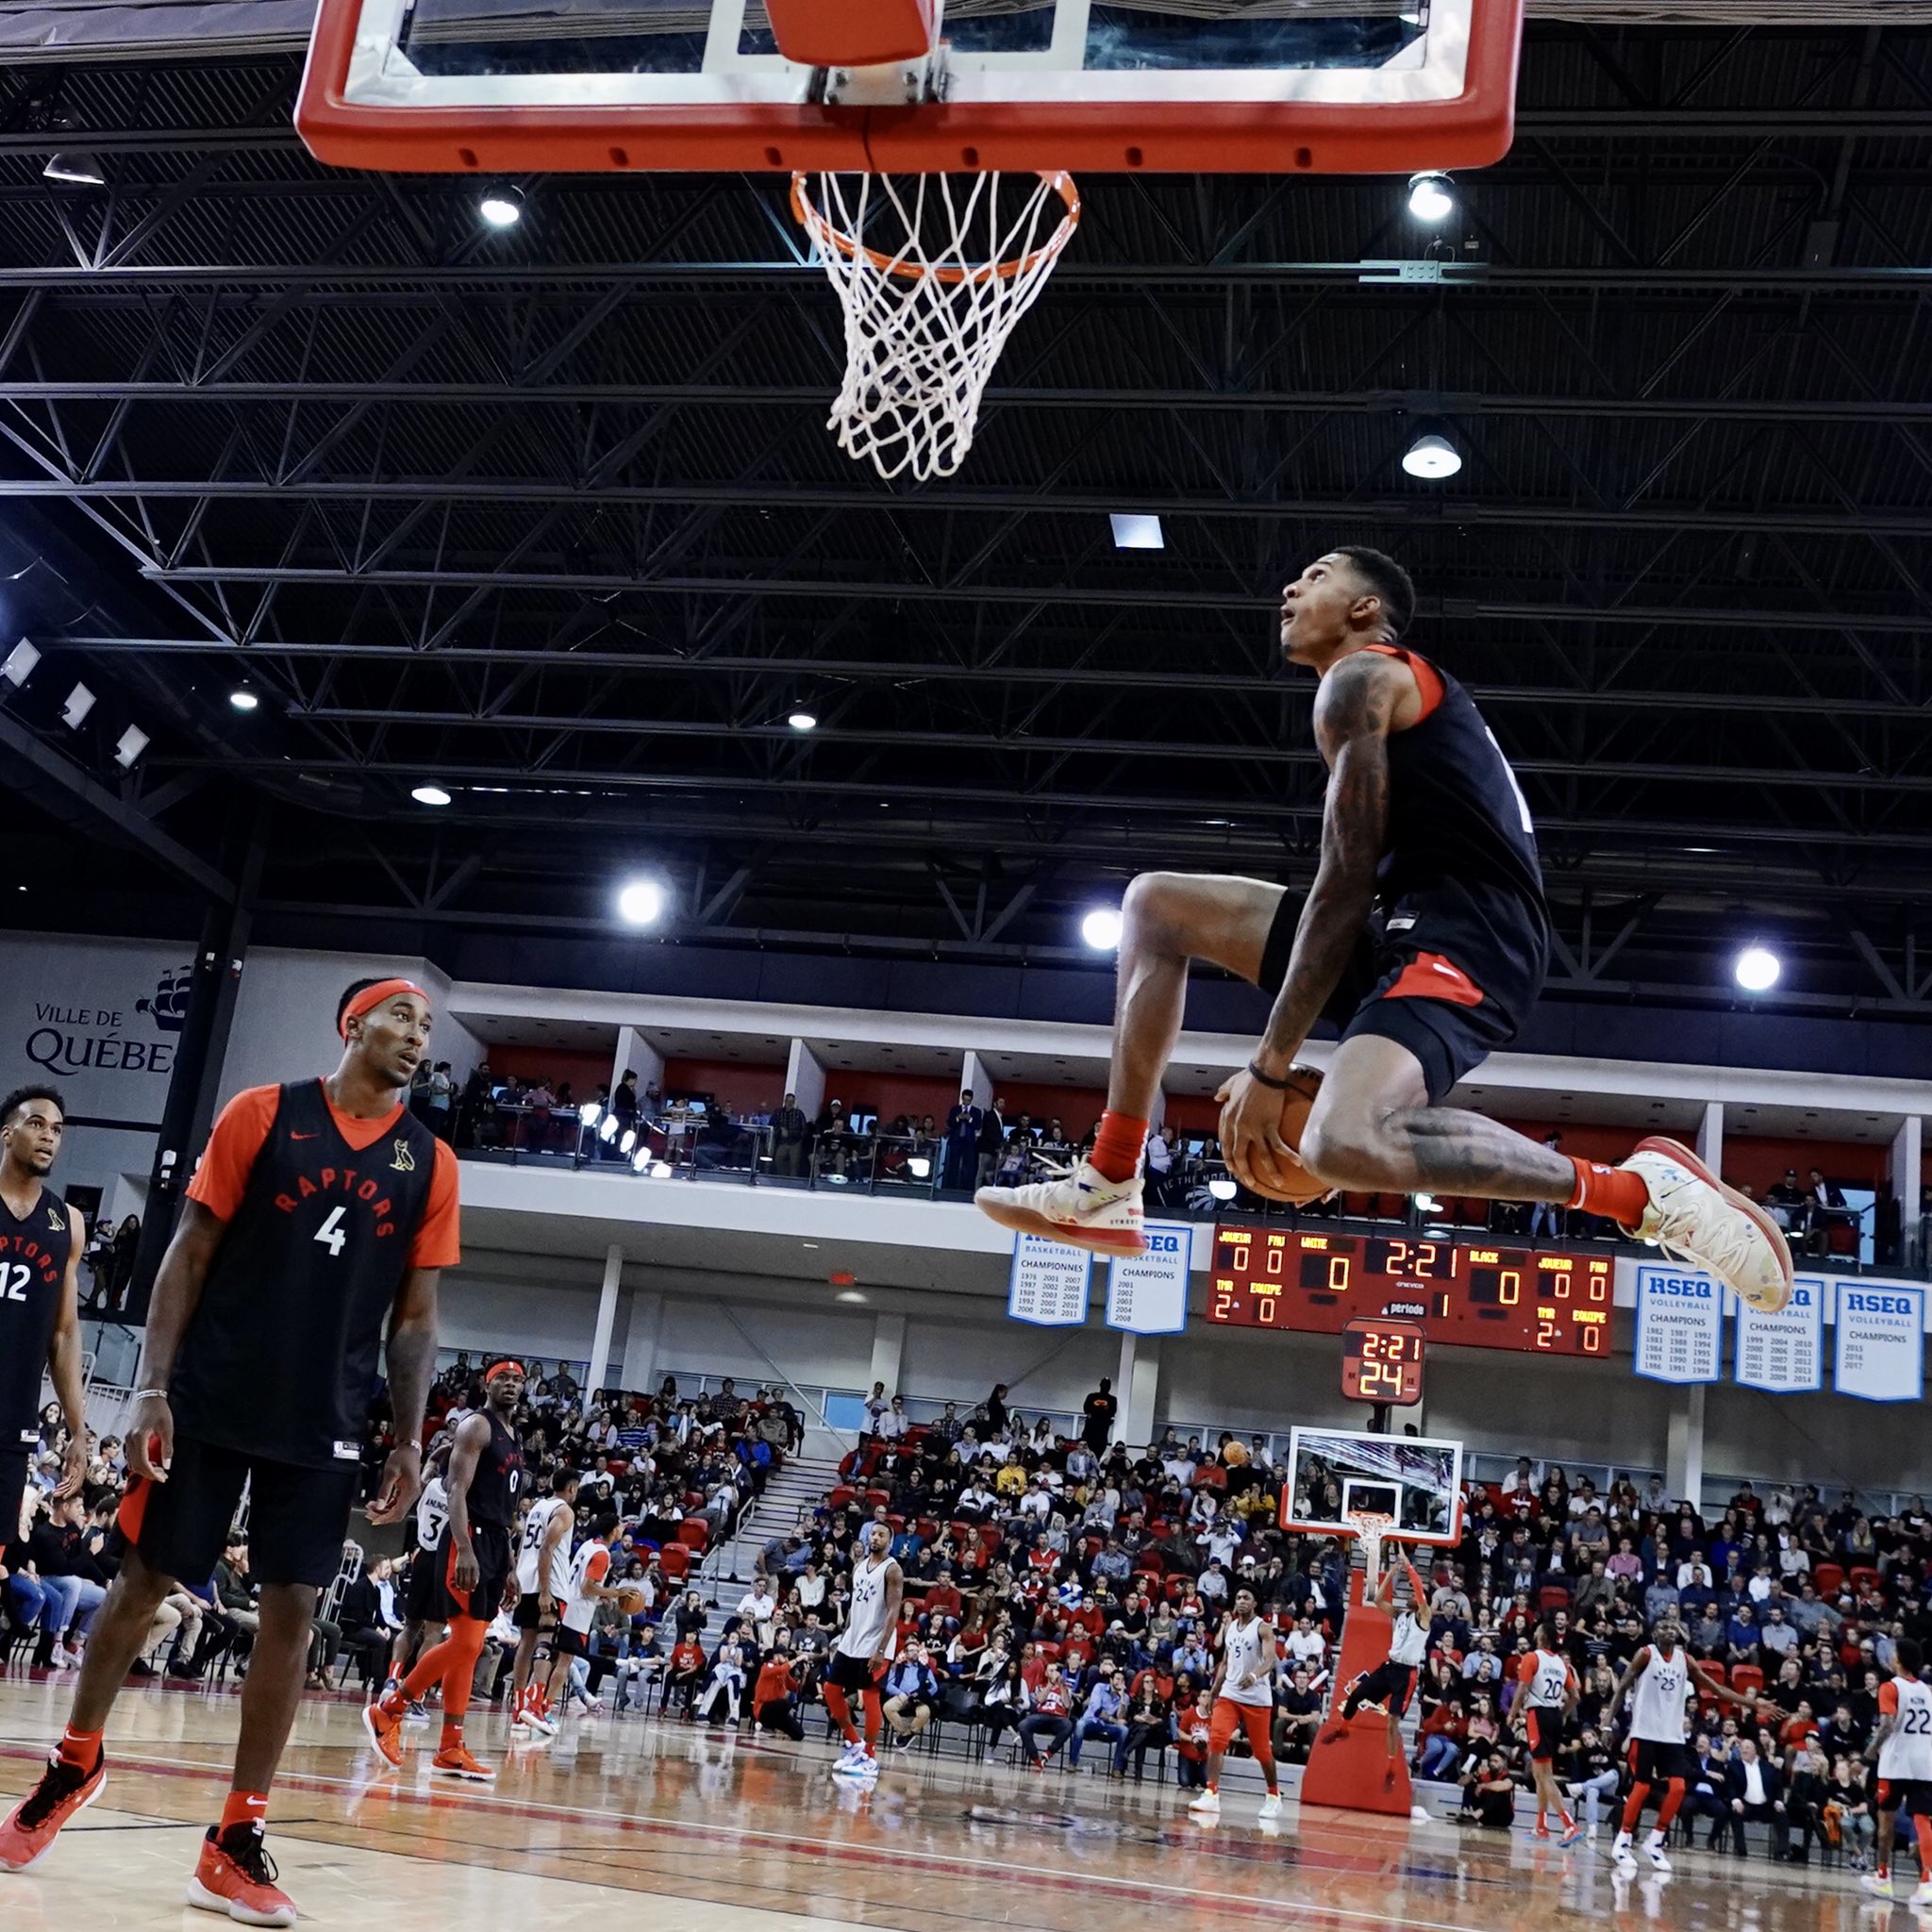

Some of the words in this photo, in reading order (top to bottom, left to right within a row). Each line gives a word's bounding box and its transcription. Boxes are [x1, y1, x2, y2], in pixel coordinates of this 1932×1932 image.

[36, 1003, 90, 1024] VILLE
[96, 1010, 123, 1026] DE
[26, 1028, 173, 1075] QUÉBE
[275, 1168, 394, 1237] RAPTORS
[313, 1206, 346, 1256] 4
[1219, 1231, 1251, 1244] JOUEUR
[1025, 1246, 1082, 1257] BASKETBALL
[1143, 1235, 1178, 1252] EQ
[1301, 1237, 1328, 1250] WHITE
[0, 1236, 58, 1282] PTORS
[1021, 1259, 1083, 1272] CHAMPIONNES
[1233, 1247, 1249, 1271] 0
[1267, 1250, 1282, 1274] 0
[1386, 1241, 1457, 1277] 2:21
[1470, 1251, 1498, 1264] BLACK
[1538, 1257, 1573, 1271] JOUEUR
[0, 1261, 31, 1302] 12
[1123, 1269, 1174, 1279] CHAMPIONS
[1329, 1257, 1349, 1291] 0
[1250, 1282, 1282, 1295] EQUIPE
[1499, 1272, 1520, 1305] 0
[1555, 1274, 1570, 1298] 0
[1590, 1276, 1605, 1301] 0
[1649, 1277, 1711, 1298] RSEQ
[1215, 1293, 1231, 1318] 2
[1259, 1298, 1274, 1323] 0
[1443, 1294, 1448, 1317] 1
[1650, 1298, 1710, 1310] VOLLEYBALL
[1847, 1294, 1912, 1314] RSEQ
[1573, 1309, 1607, 1324] EQUIPE
[1650, 1314, 1706, 1326] CHAMPIONS
[1849, 1316, 1911, 1327] VOLLEYBALL
[1537, 1323, 1553, 1347] 2
[1583, 1326, 1599, 1351] 0
[1750, 1323, 1807, 1334] CHAMPIONS
[1849, 1331, 1907, 1343] CHAMPIONS
[1363, 1333, 1420, 1360] 2:21
[1360, 1361, 1402, 1395] 24
[509, 1470, 519, 1493] 0
[423, 1513, 442, 1541] 3
[857, 1589, 869, 1603] 24
[1236, 1646, 1241, 1658] 5
[1543, 1678, 1562, 1700] 20
[1661, 1677, 1674, 1690] 25
[1905, 1708, 1931, 1735] 22
